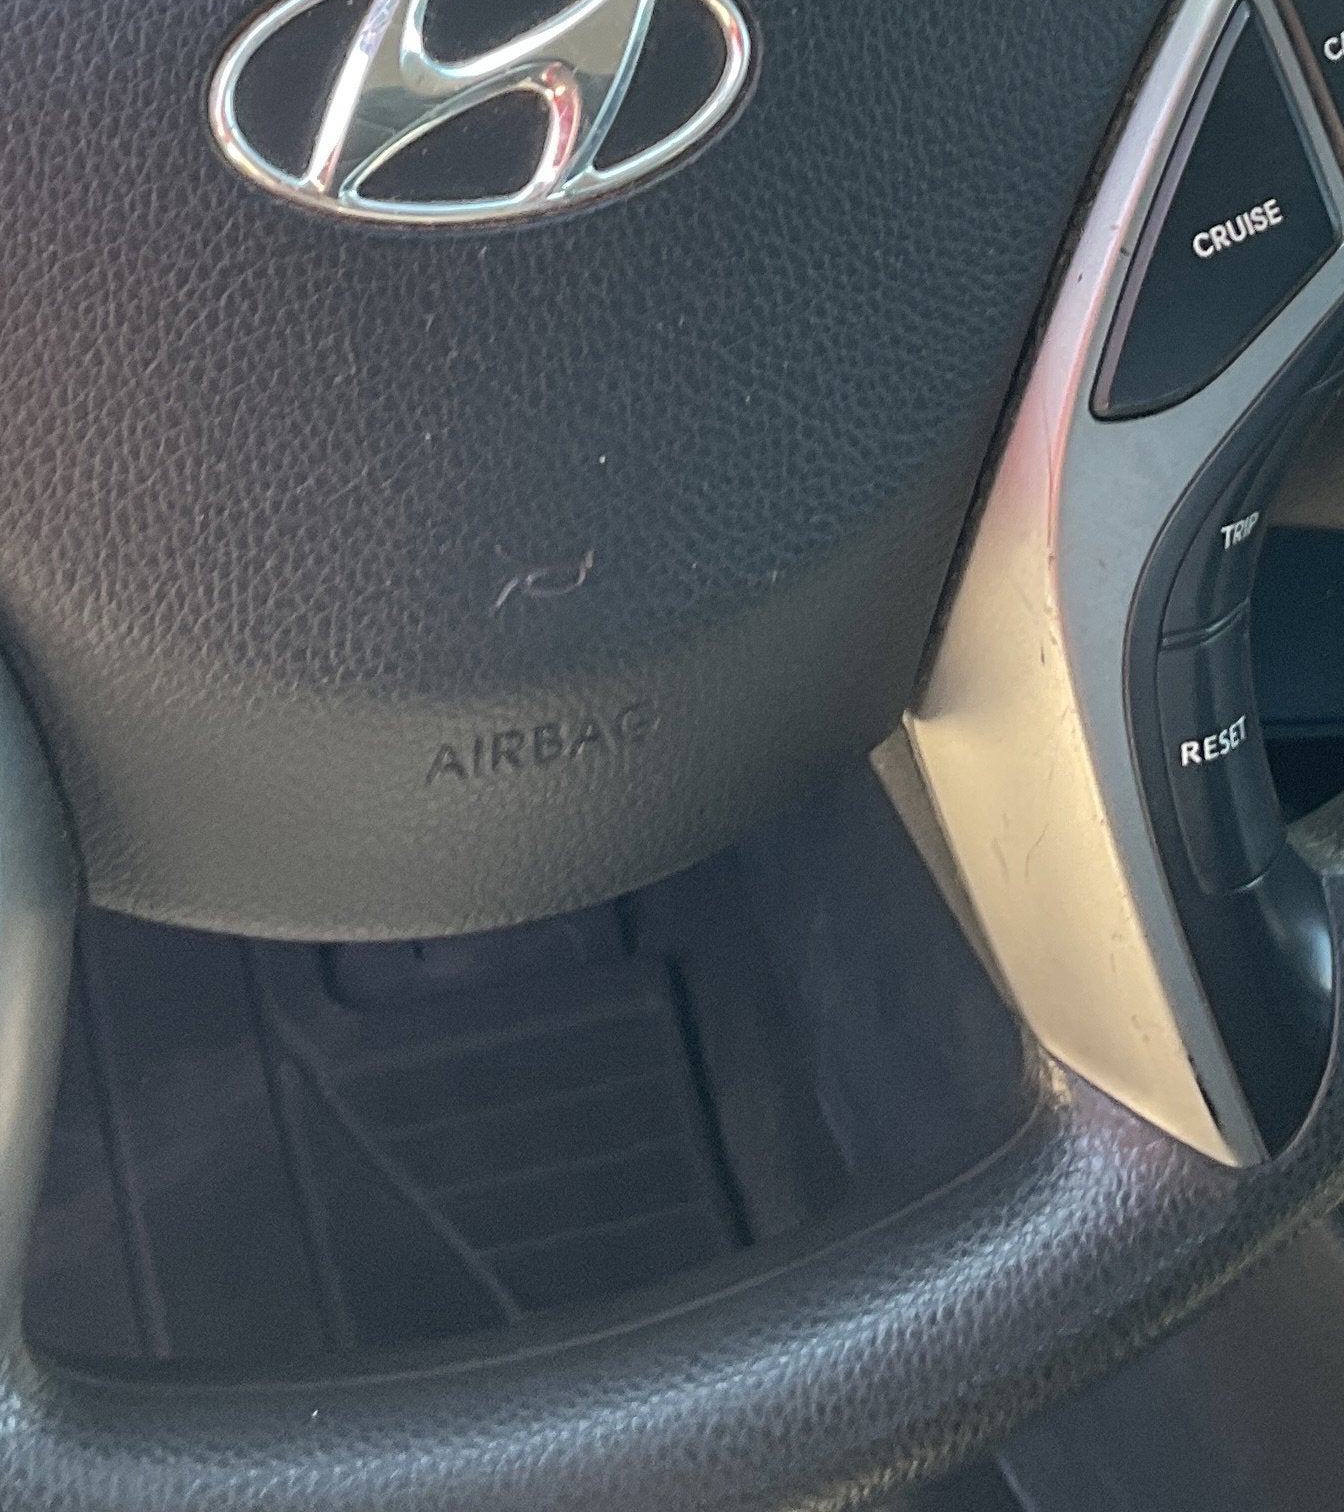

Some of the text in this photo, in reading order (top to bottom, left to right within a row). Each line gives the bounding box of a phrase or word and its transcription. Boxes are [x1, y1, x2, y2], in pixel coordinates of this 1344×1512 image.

[1192, 199, 1284, 258] CRUISE
[1220, 511, 1260, 549] TRIP
[424, 697, 660, 787] AIRBAG
[1180, 714, 1248, 767] RESET
